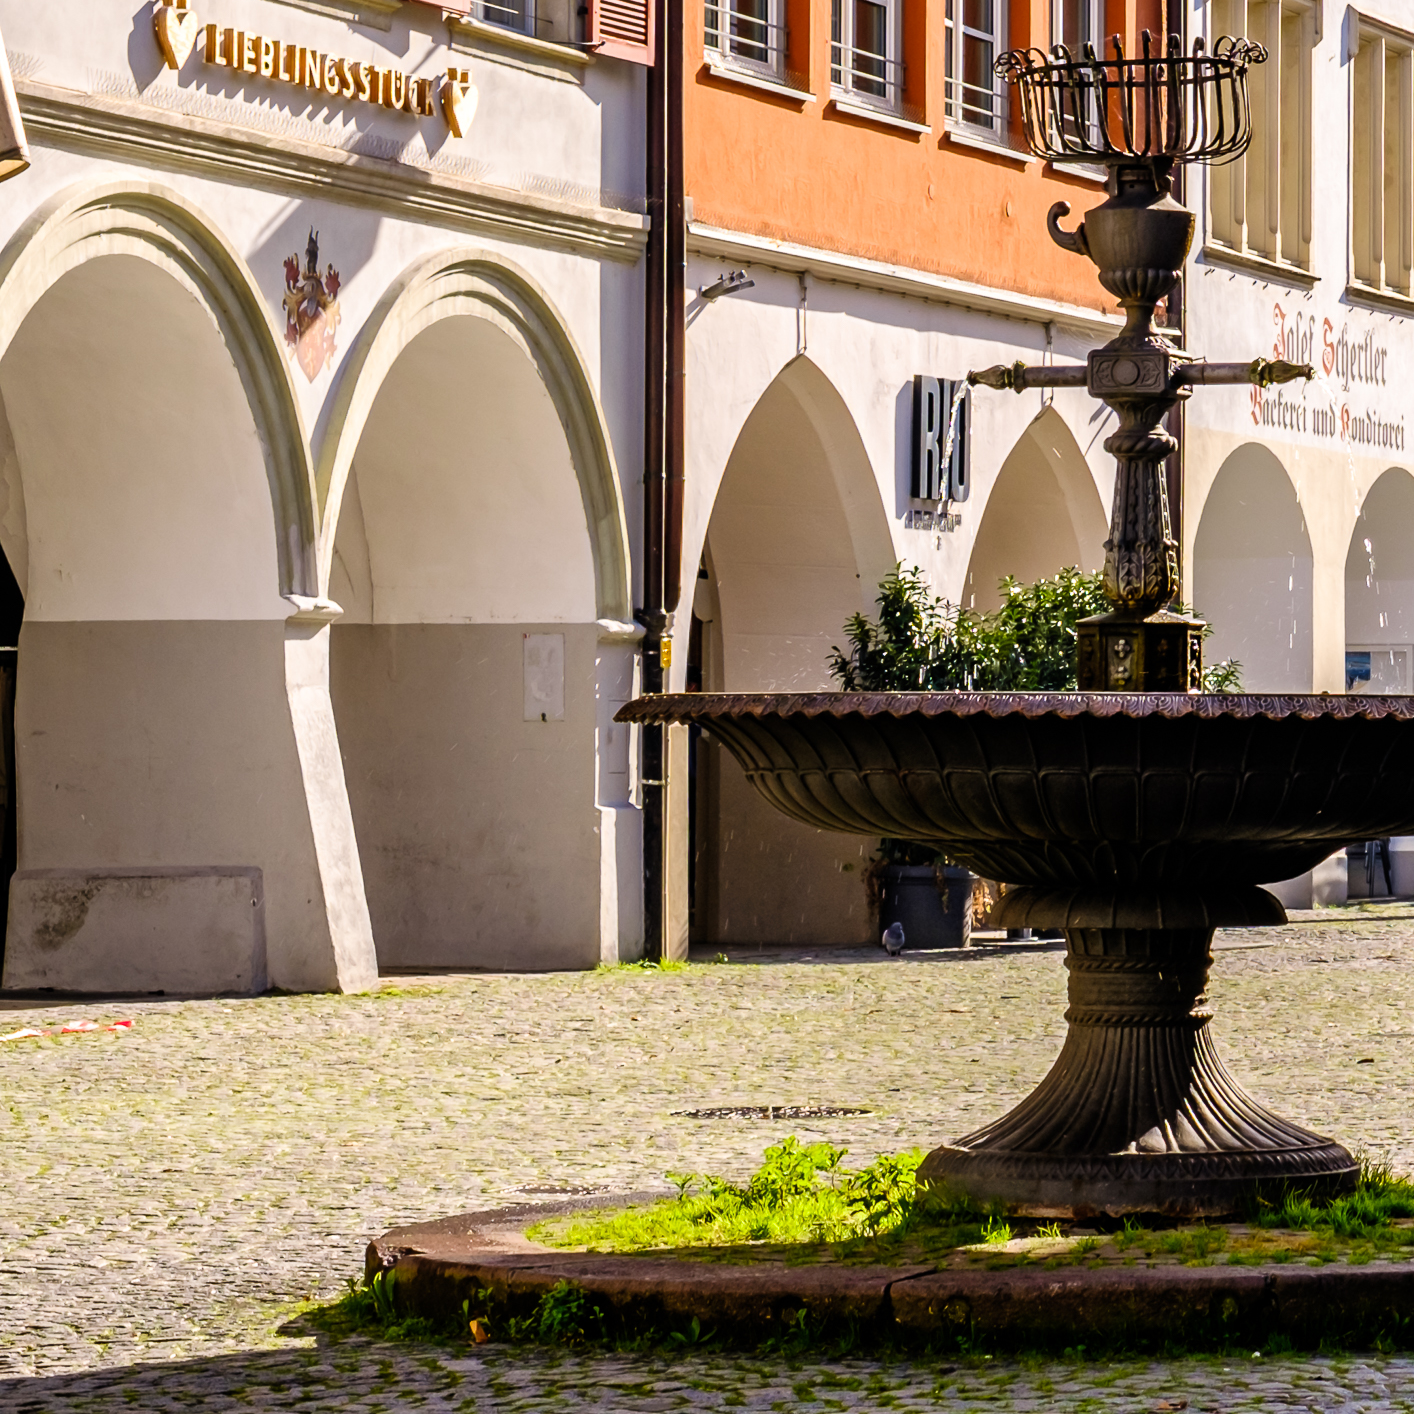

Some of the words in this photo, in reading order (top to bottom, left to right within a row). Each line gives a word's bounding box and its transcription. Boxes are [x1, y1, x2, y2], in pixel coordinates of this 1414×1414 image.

[206, 23, 438, 117] LIEBLINGSSTÜCK
[1250, 383, 1307, 433] Bäckerei
[1312, 398, 1336, 438] und
[1340, 402, 1405, 452] Konditorei
